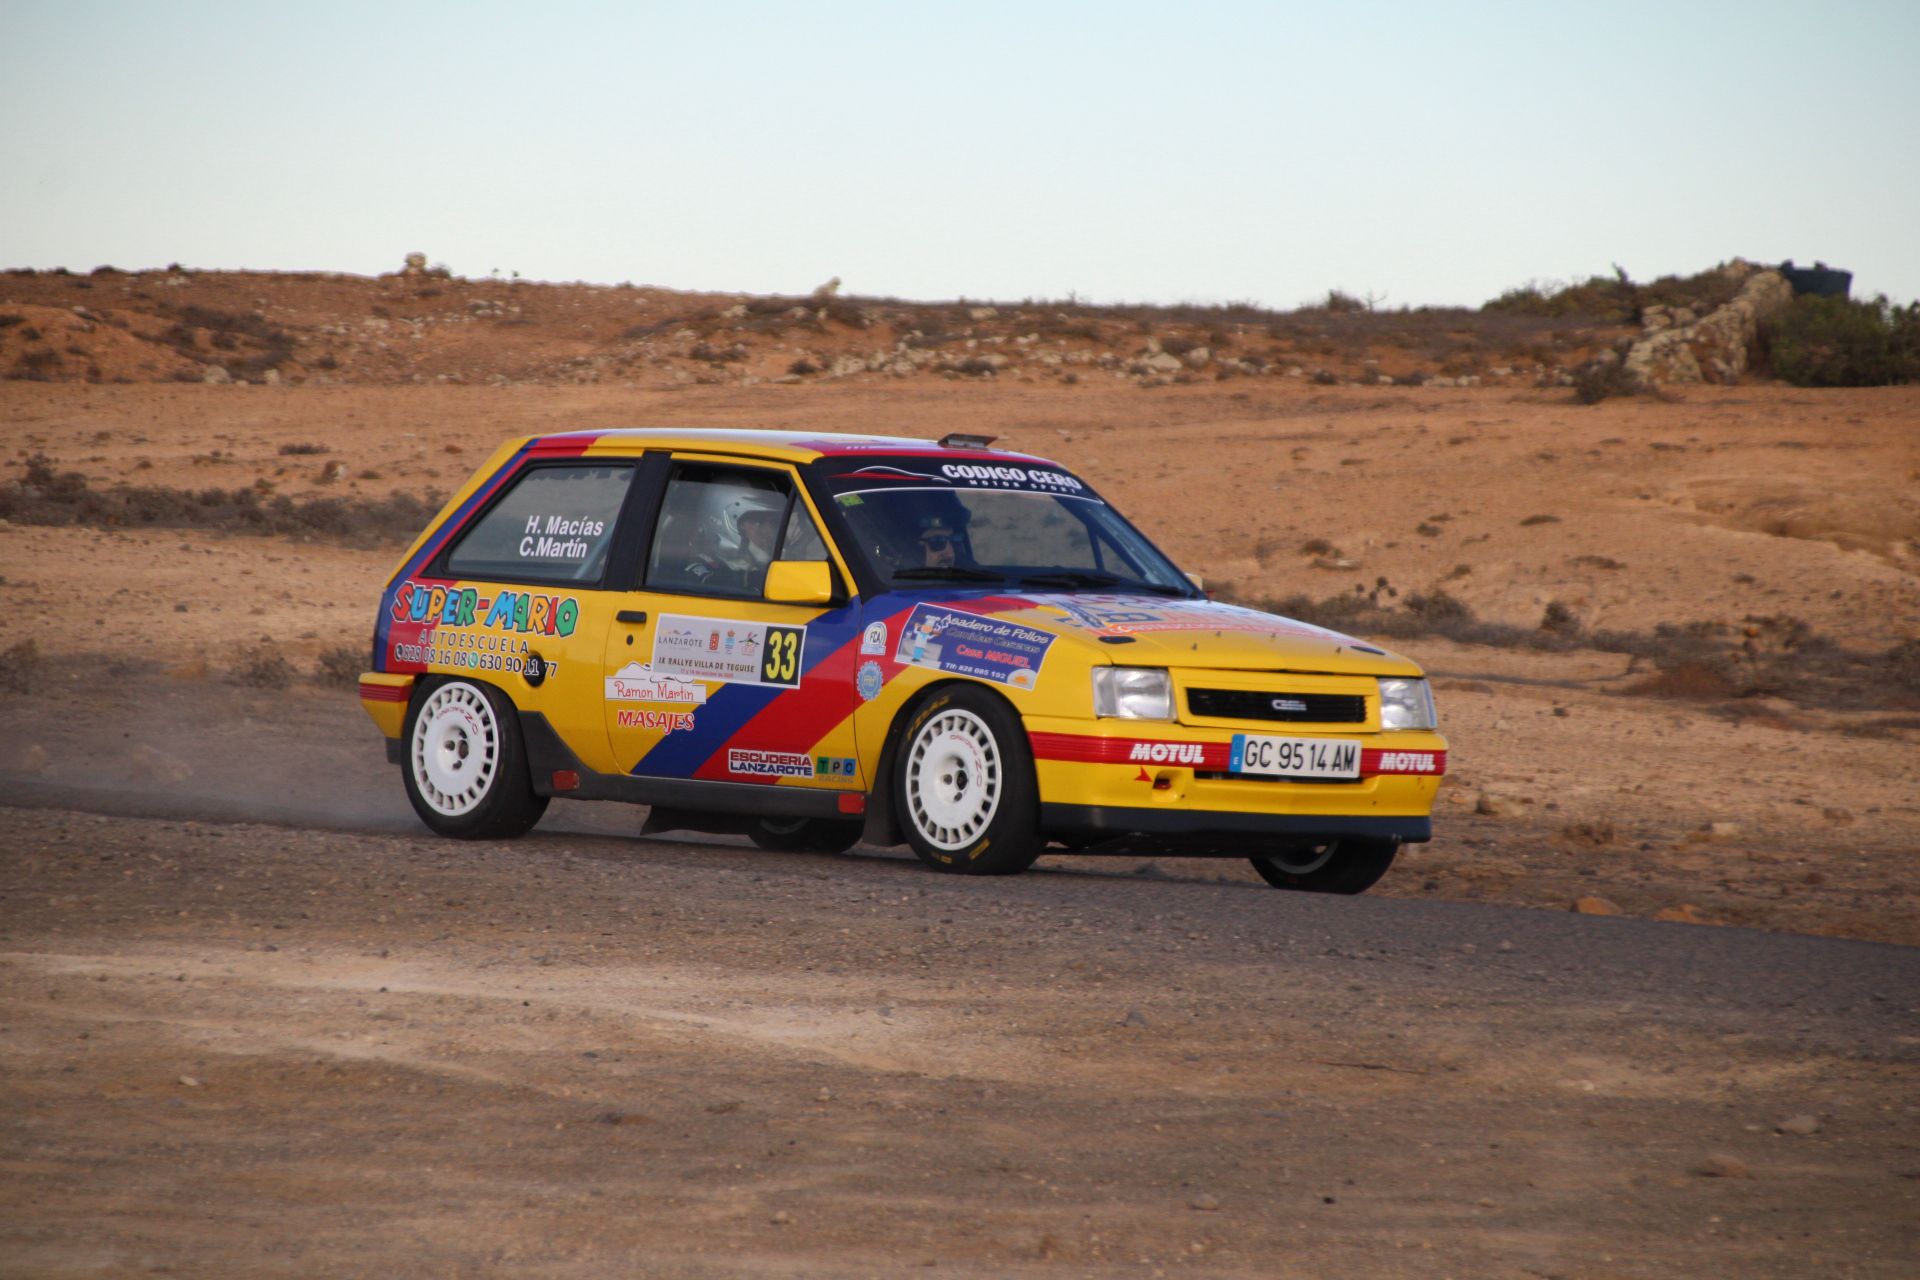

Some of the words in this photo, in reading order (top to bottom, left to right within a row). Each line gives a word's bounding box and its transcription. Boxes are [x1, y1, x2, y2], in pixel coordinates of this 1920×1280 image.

[942, 464, 1027, 481] CODIGO
[1028, 470, 1082, 490] CERO
[969, 479, 1020, 488] MOTOR
[1030, 483, 1076, 494] SPORT
[525, 515, 541, 534] H.
[545, 515, 604, 536] Macías
[519, 536, 588, 558] C.Martín
[941, 614, 993, 632] Asadero
[994, 625, 1010, 635] de
[1011, 628, 1049, 644] Pollos
[418, 629, 529, 654] AUTOESCUELA
[658, 636, 703, 648] LANZAROTE
[956, 644, 984, 660] Casa
[402, 645, 421, 661] 828
[423, 647, 435, 662] 08
[438, 649, 450, 665] 16
[453, 651, 467, 666] 08
[479, 653, 501, 670] 630
[506, 656, 522, 672] 90
[525, 658, 539, 675] 11
[544, 661, 557, 678] 77
[668, 656, 692, 667] RALLYE
[694, 660, 714, 669] VILLA
[715, 662, 724, 670] DE
[727, 663, 755, 673] TEGUISE
[765, 630, 798, 681] 33
[614, 681, 653, 699] Ramon
[657, 682, 694, 701] Martin
[617, 710, 695, 735] MASAJES
[730, 751, 812, 767] ESCUDERIA
[1129, 743, 1205, 764] MOTUL
[1245, 740, 1272, 768] GC
[1332, 745, 1355, 772] AM
[1379, 752, 1436, 771] MOTUL
[730, 762, 813, 776] LANZAROTE
